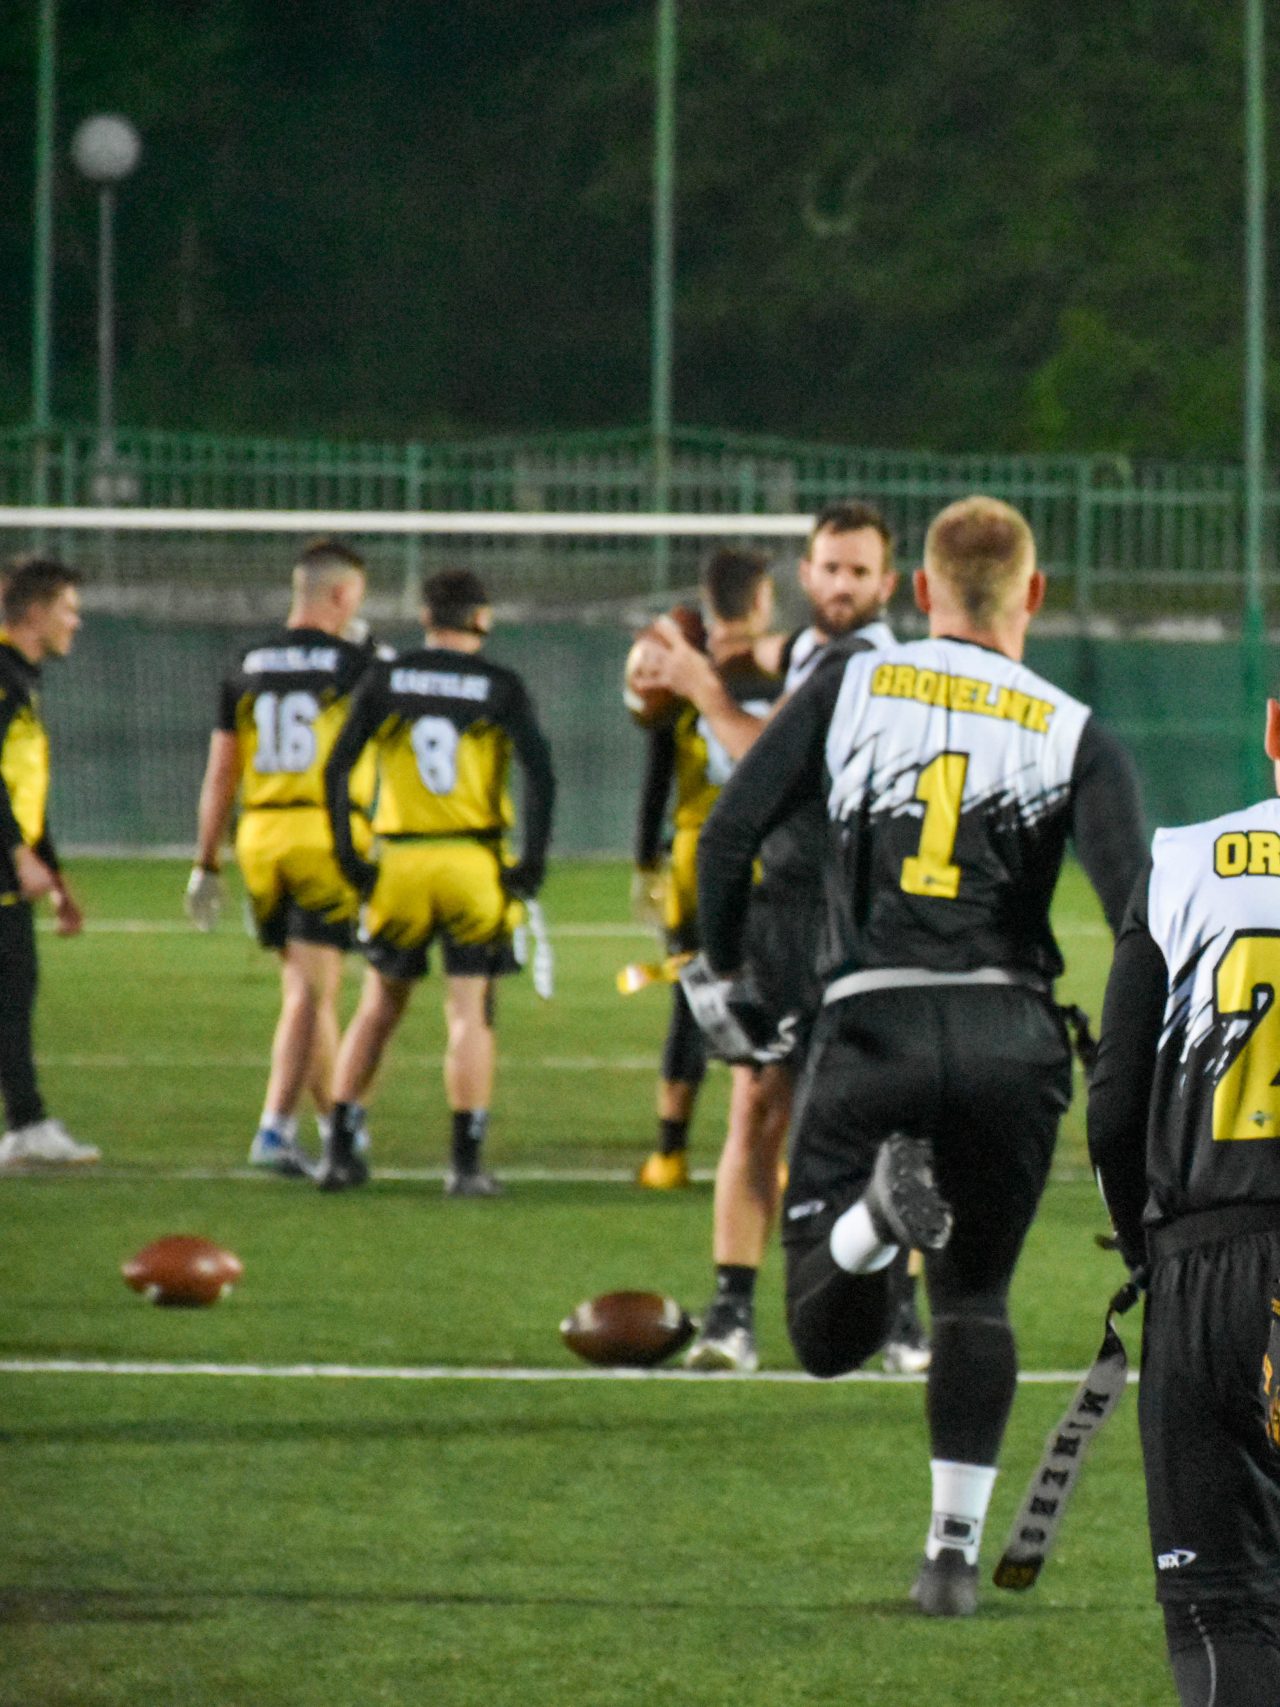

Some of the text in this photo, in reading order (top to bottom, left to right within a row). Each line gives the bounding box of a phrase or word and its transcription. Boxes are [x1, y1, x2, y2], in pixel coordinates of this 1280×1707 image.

[254, 690, 318, 773] 16
[411, 716, 459, 795] 8
[900, 751, 969, 898] 1
